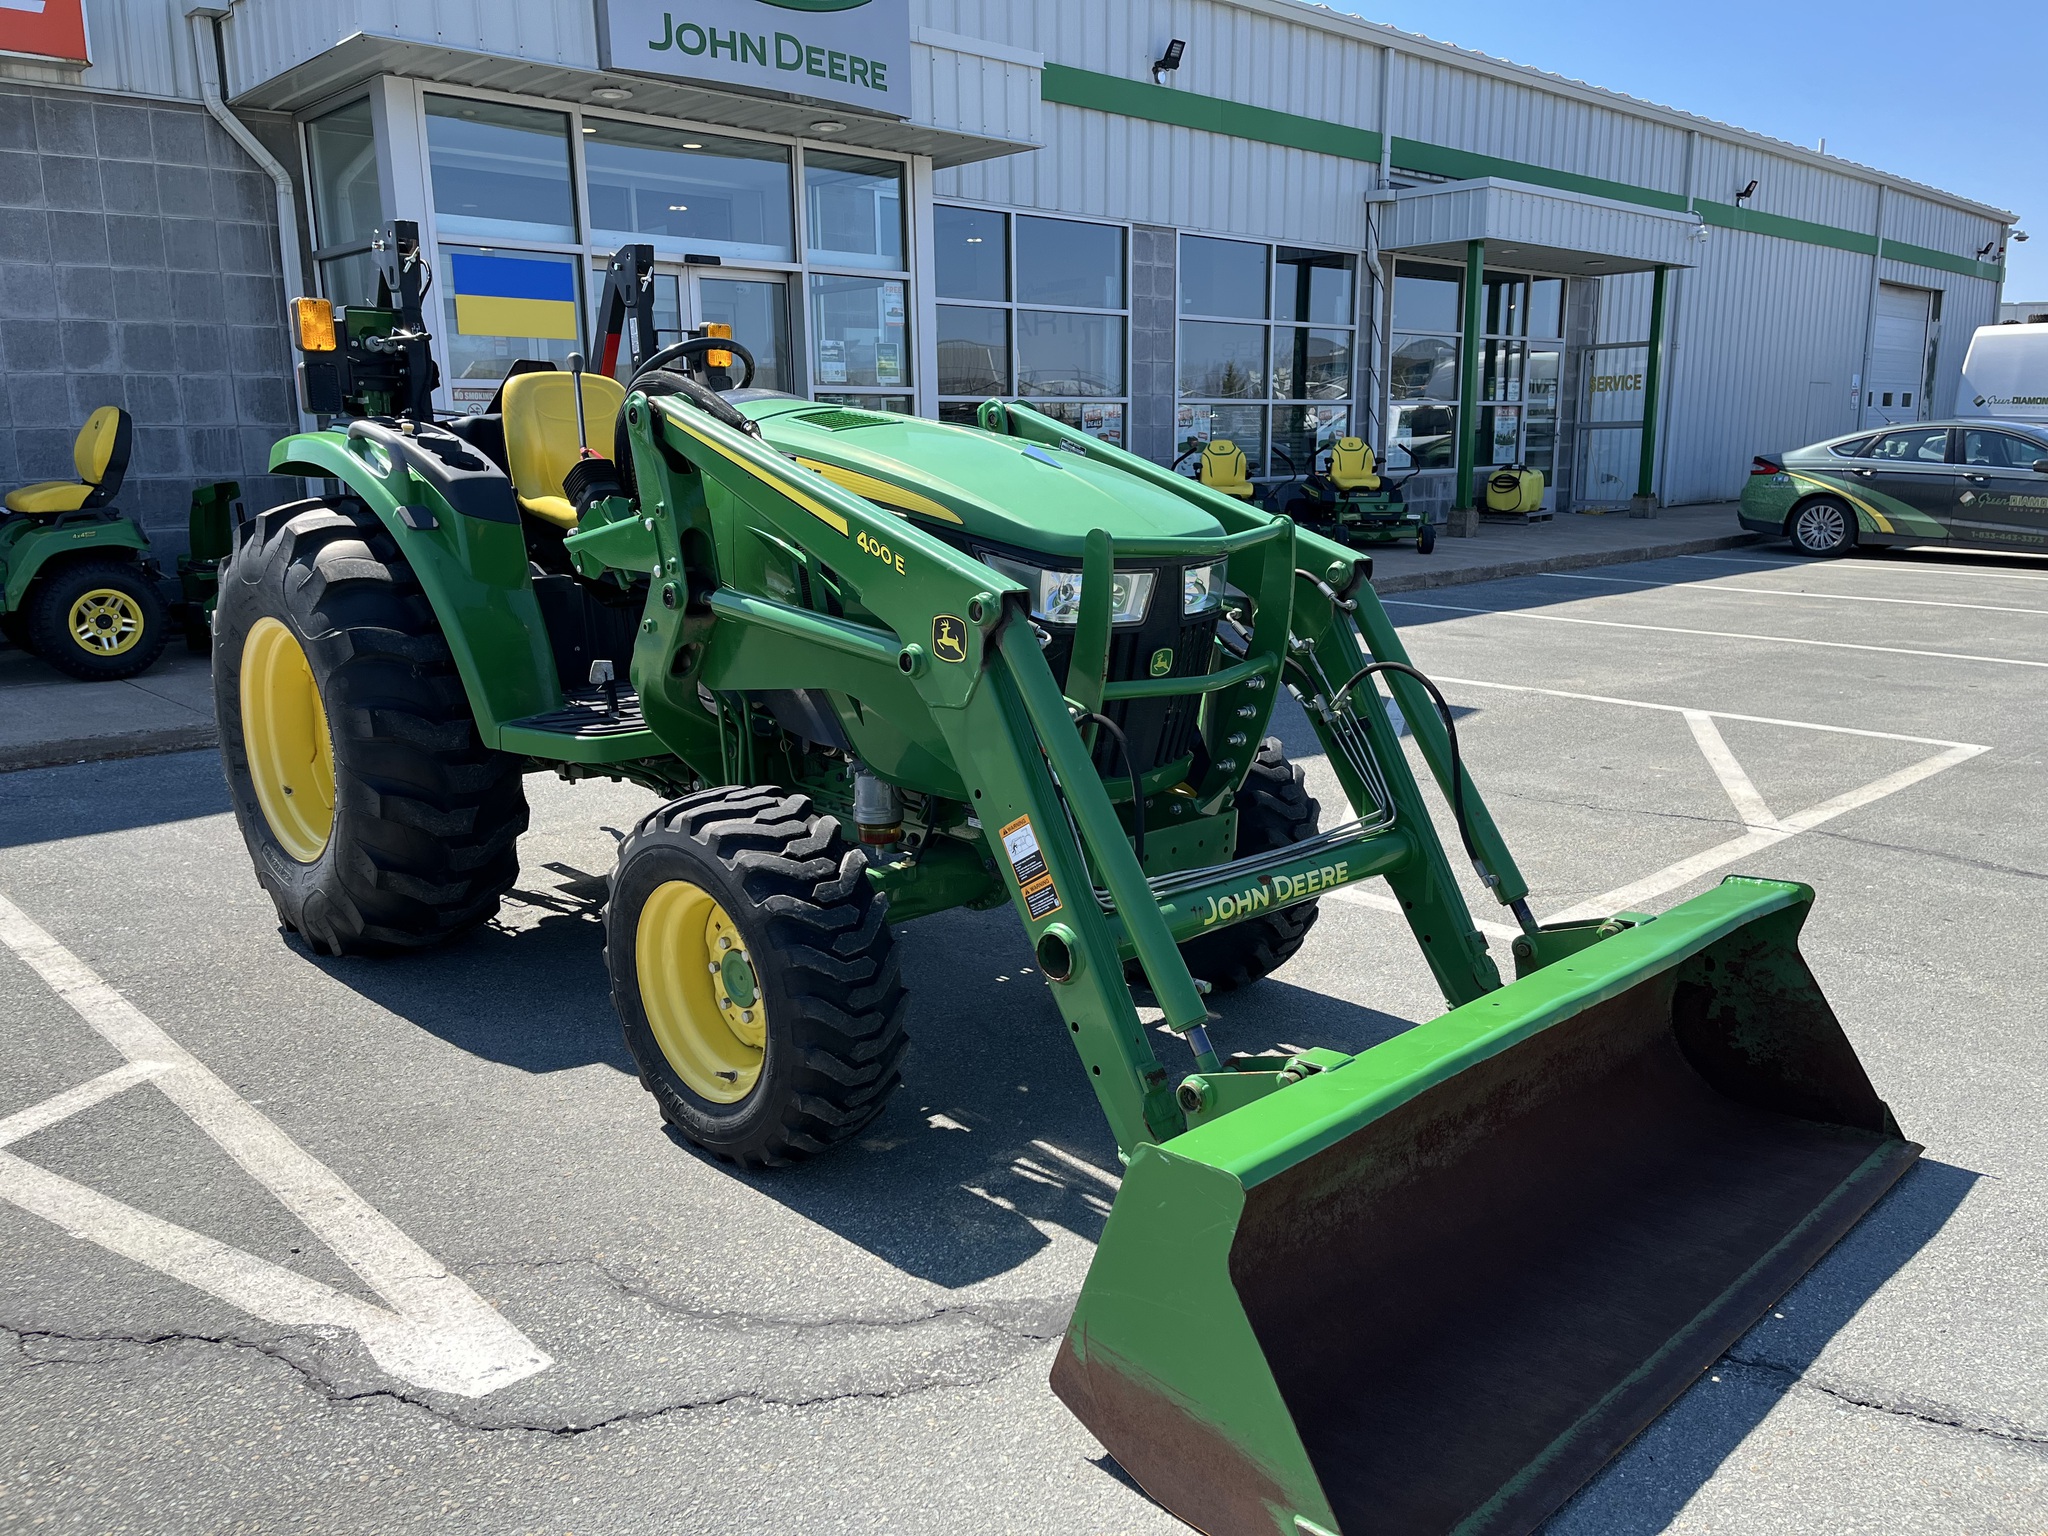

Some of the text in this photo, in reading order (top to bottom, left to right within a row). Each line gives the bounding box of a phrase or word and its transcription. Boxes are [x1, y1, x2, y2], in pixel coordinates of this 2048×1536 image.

[649, 12, 888, 92] JOHN DEERE
[1589, 374, 1642, 392] SERVICE
[454, 391, 464, 400] NO
[1978, 493, 2009, 508] Green
[856, 531, 906, 576] 400 E
[1007, 818, 1027, 832] WARNING
[1030, 878, 1050, 892] WARNING
[1204, 861, 1349, 926] JOHN DEERE
